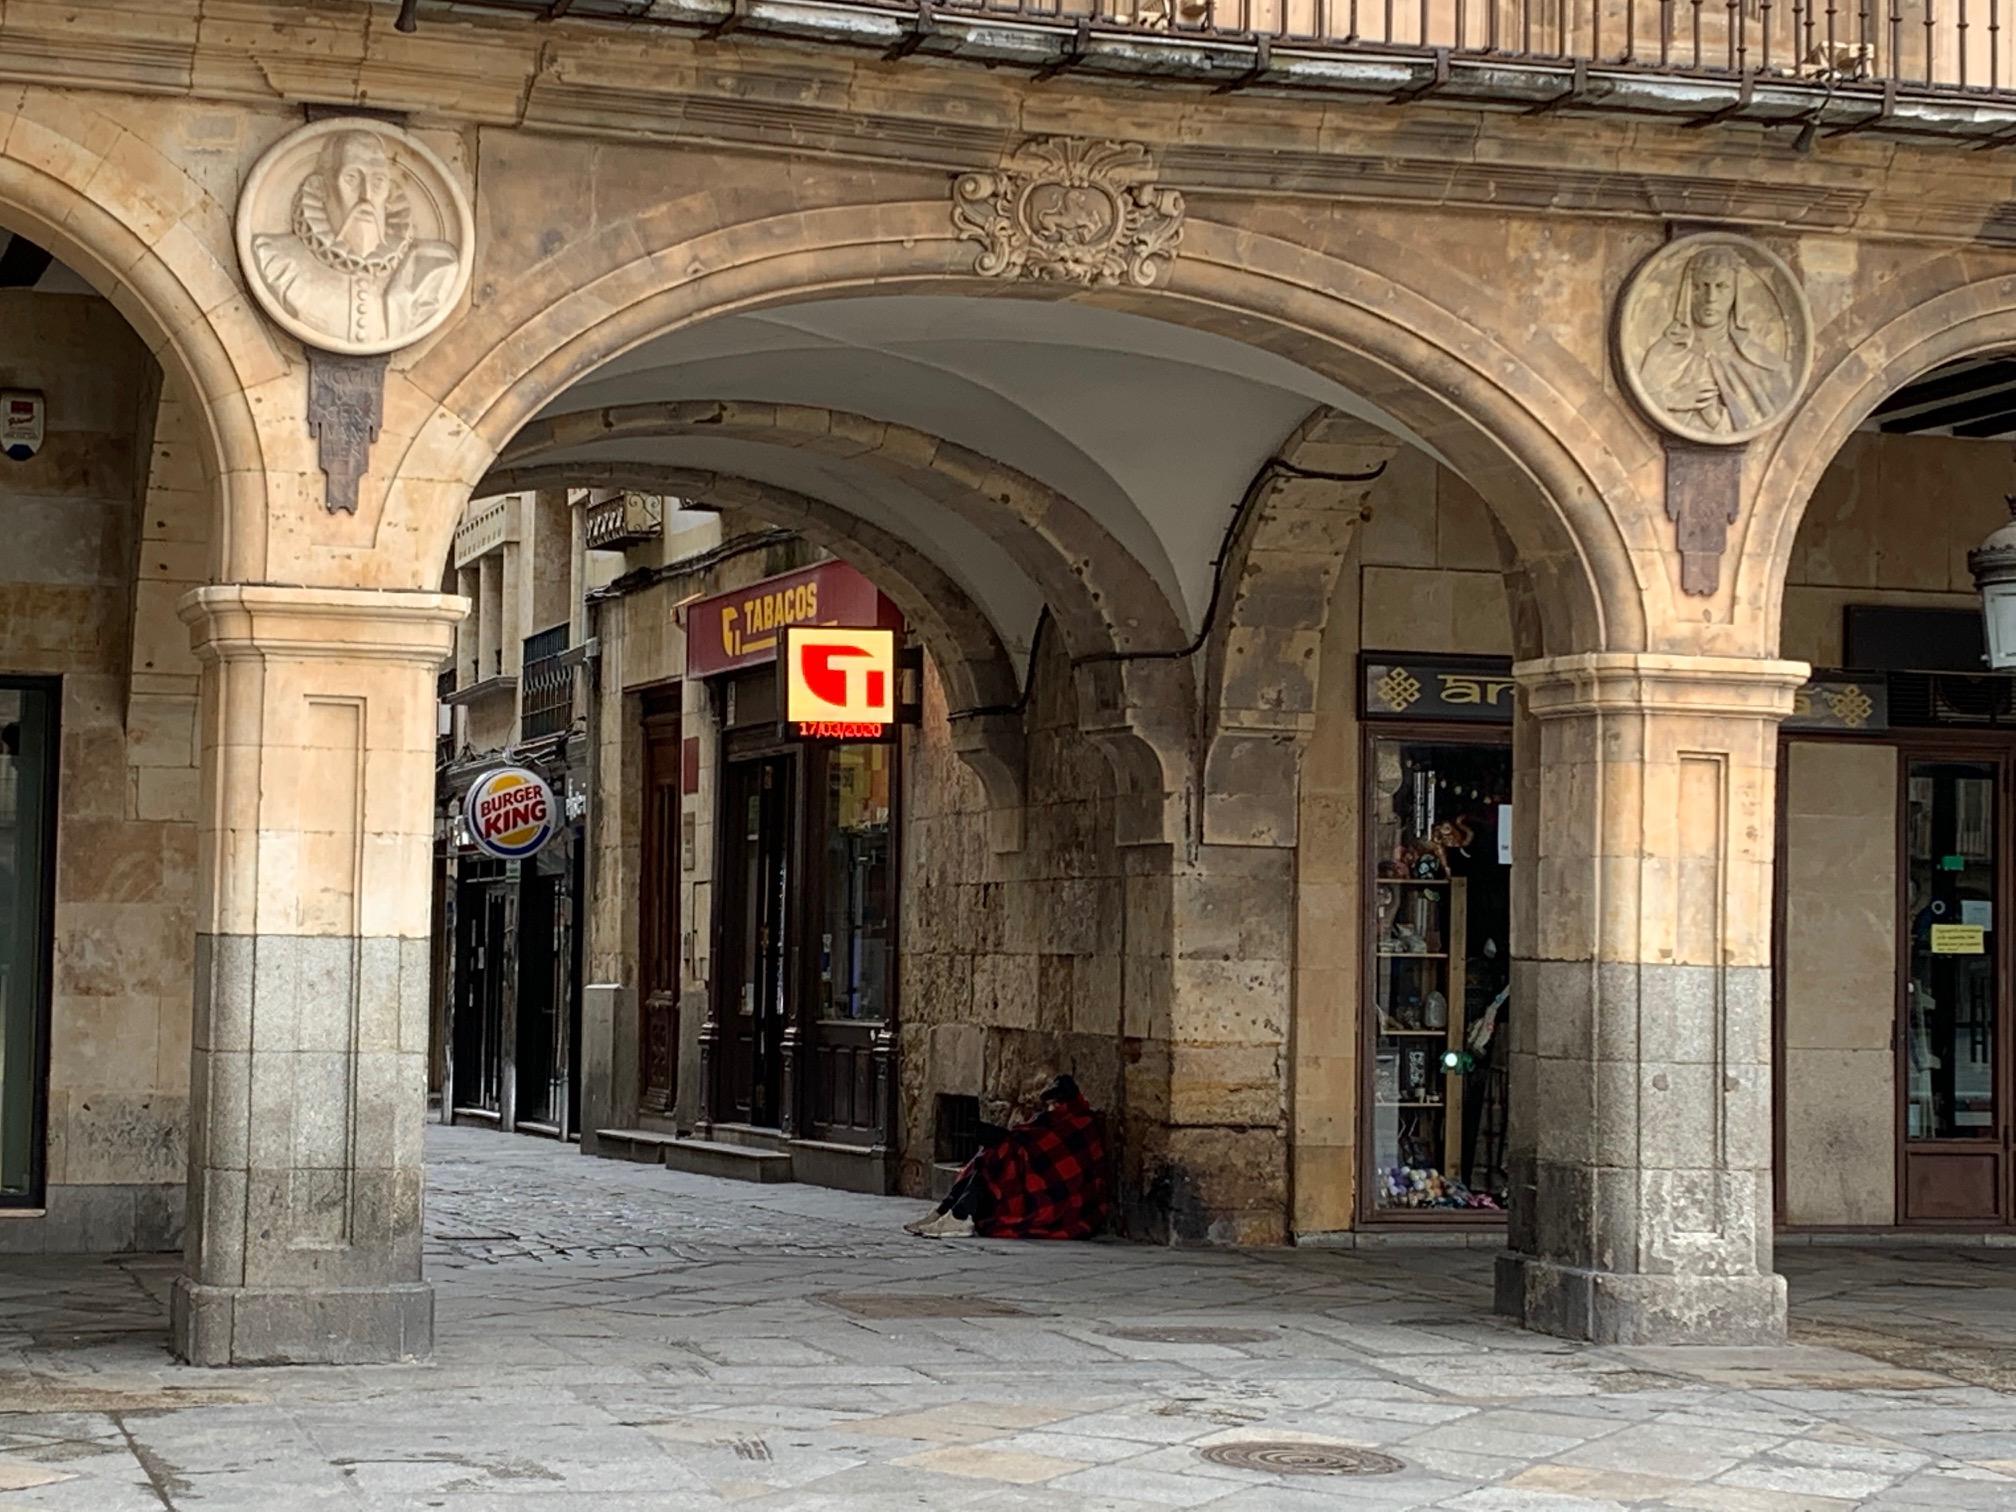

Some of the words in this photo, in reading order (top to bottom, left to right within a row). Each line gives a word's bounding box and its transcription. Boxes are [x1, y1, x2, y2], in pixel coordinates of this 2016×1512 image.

[744, 582, 817, 635] TABACOS
[1438, 674, 1515, 705] ar
[800, 721, 882, 740] 17/03/2020
[480, 785, 543, 818] BURGER
[484, 800, 546, 839] KING
